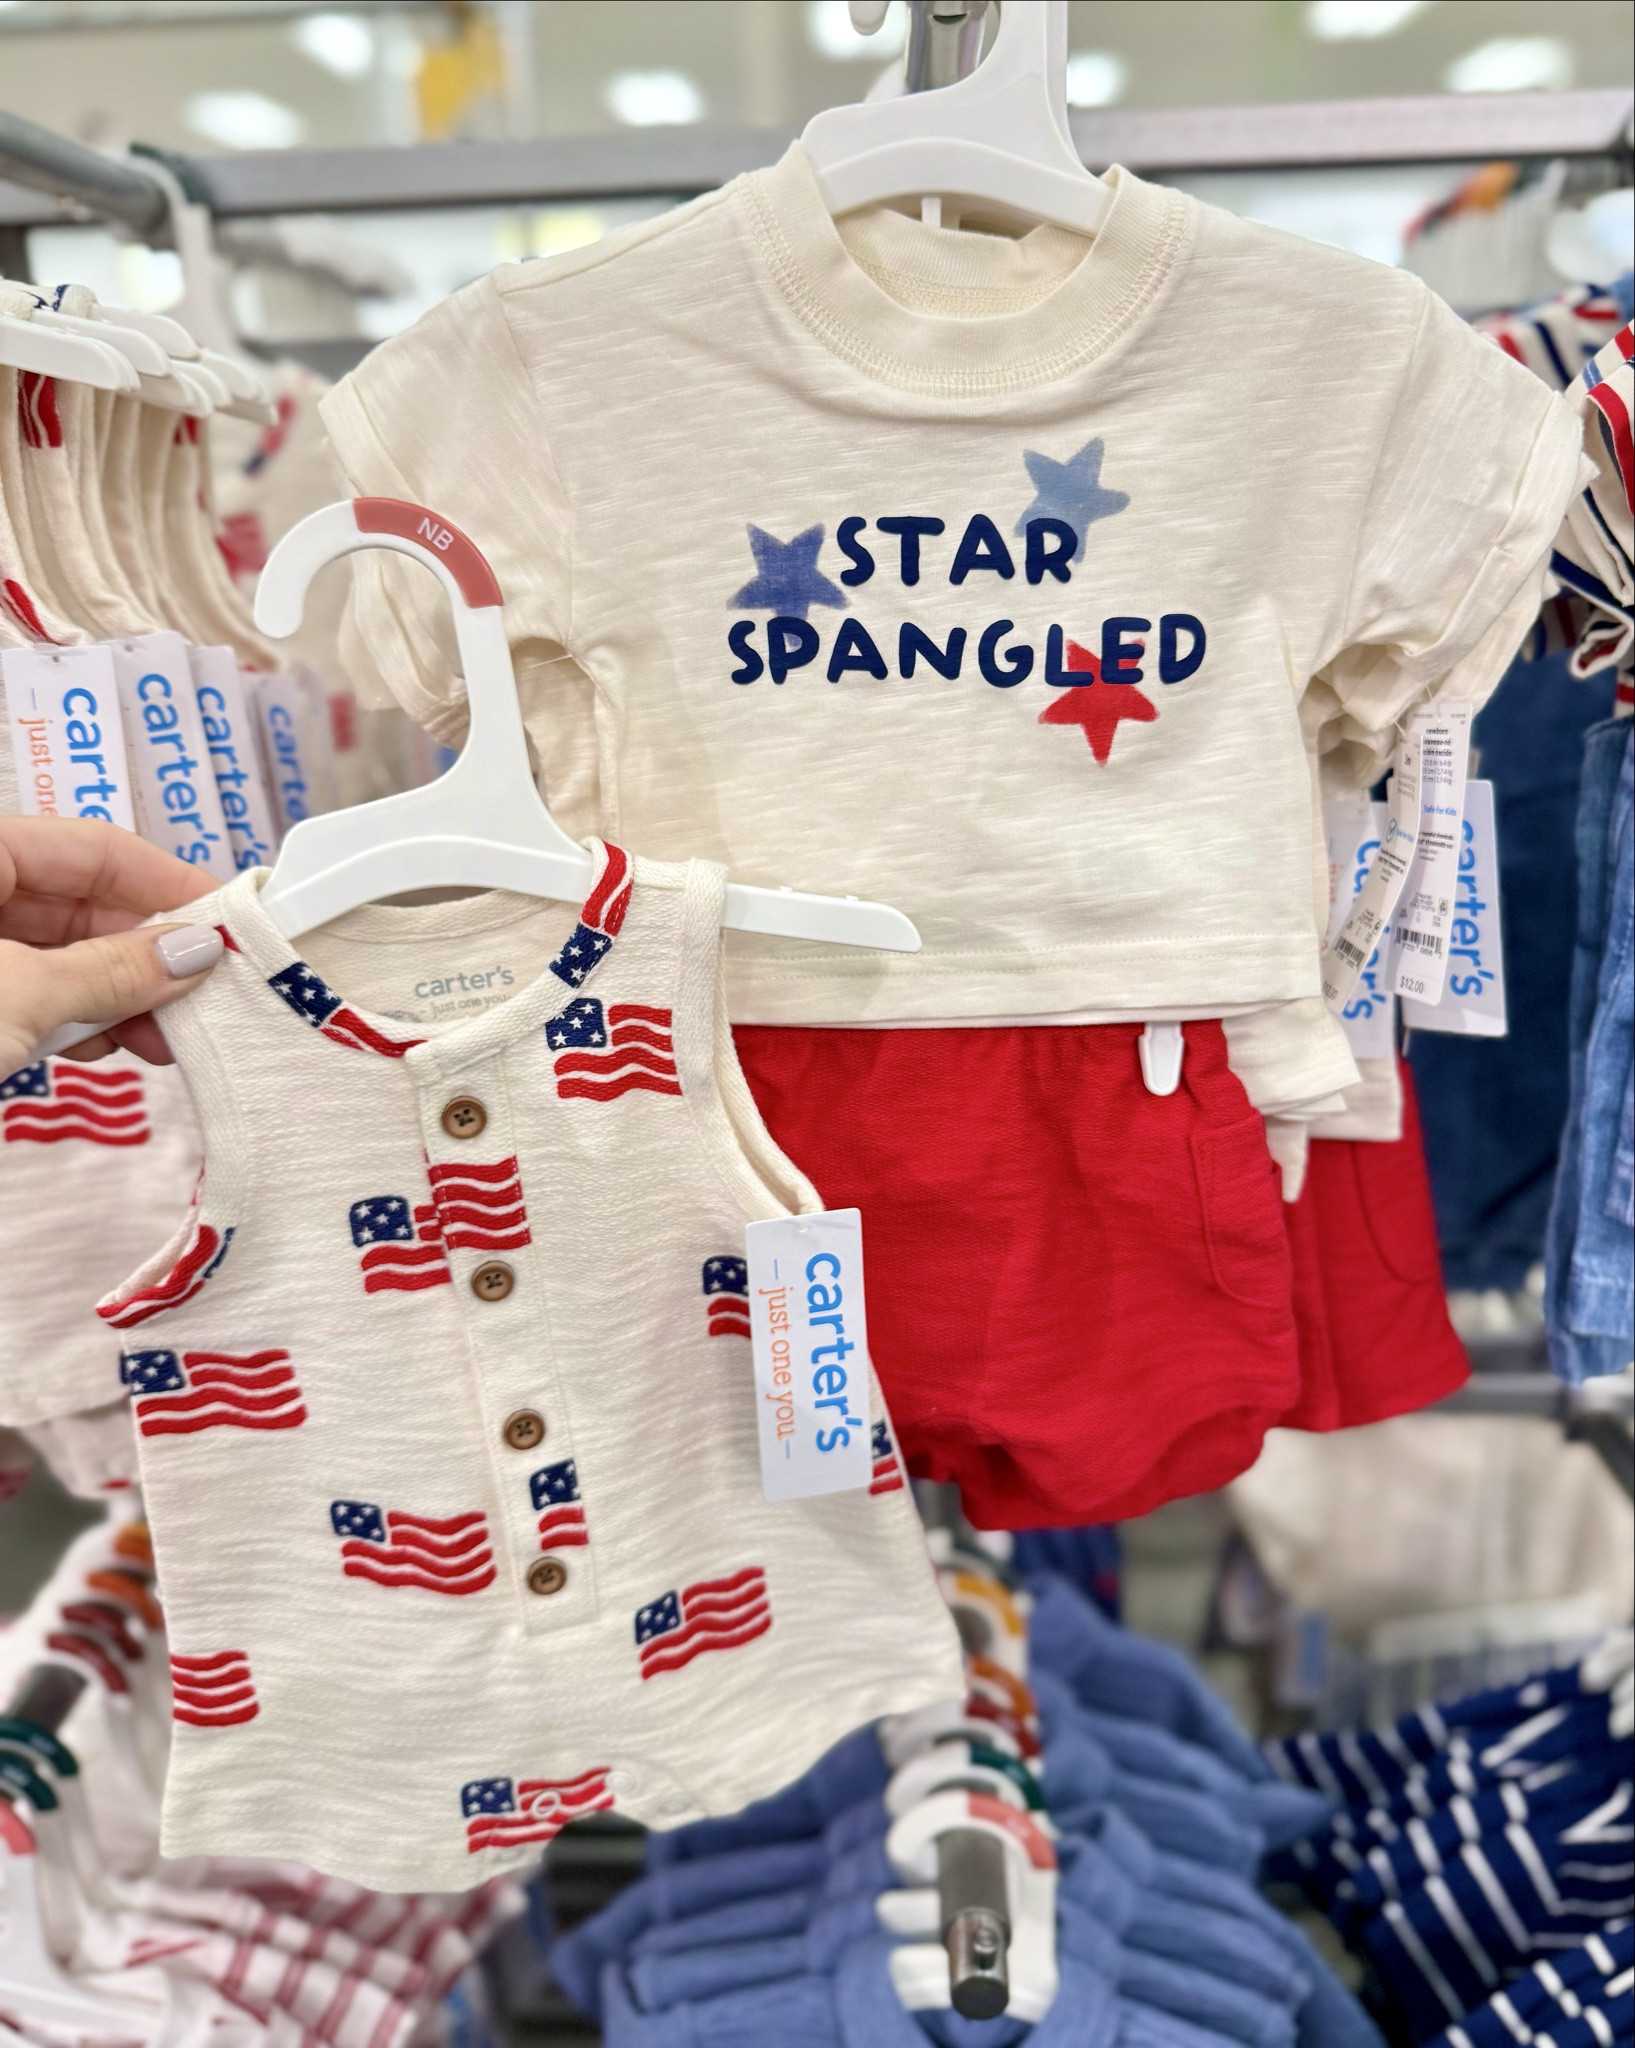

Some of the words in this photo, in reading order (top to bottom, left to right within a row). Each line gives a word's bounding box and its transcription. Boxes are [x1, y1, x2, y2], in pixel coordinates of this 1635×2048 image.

[417, 517, 455, 552] NB
[836, 513, 1079, 587] STAR
[727, 612, 1206, 689] SPANGLED
[17, 718, 54, 767] just
[62, 687, 119, 823] carte
[268, 704, 308, 821] carte
[137, 673, 221, 865] carter's
[414, 966, 515, 999] carter's
[1400, 976, 1424, 994] $12.00
[758, 1285, 794, 1334] just
[771, 1339, 792, 1387] one
[806, 1253, 863, 1453] carter's
[765, 1390, 796, 1439] you
